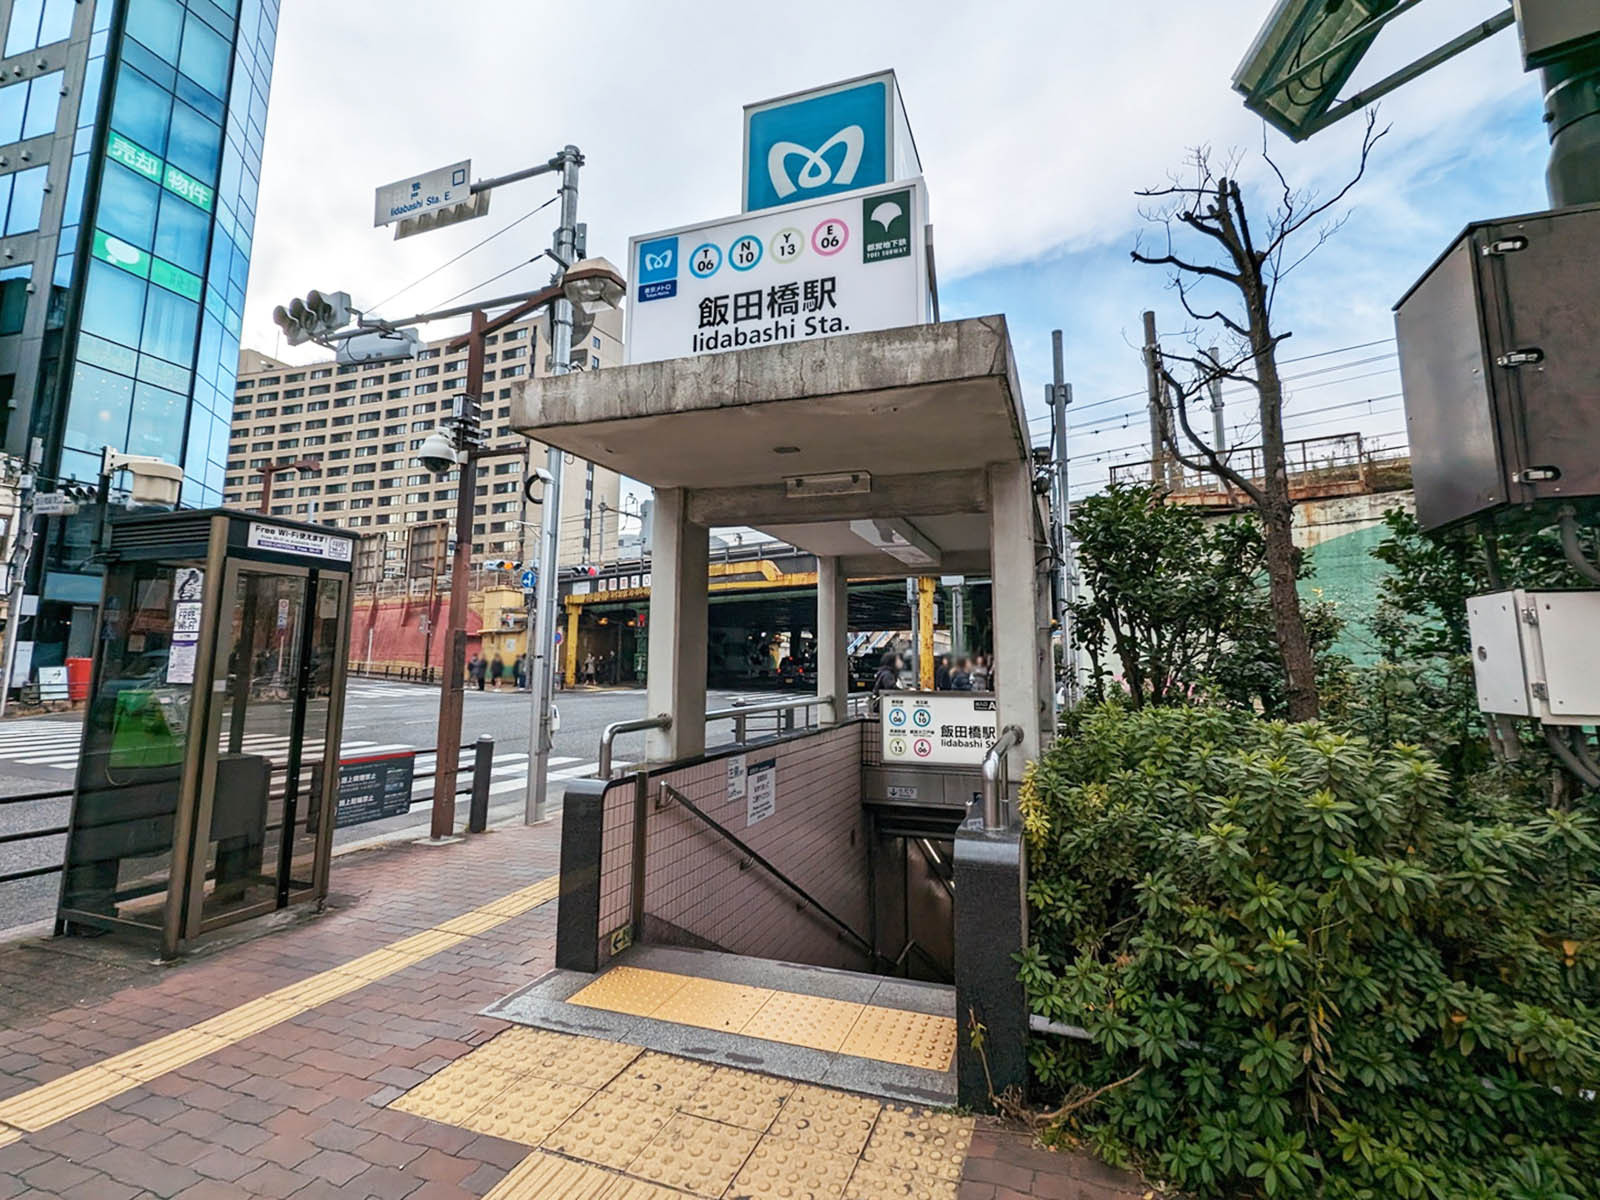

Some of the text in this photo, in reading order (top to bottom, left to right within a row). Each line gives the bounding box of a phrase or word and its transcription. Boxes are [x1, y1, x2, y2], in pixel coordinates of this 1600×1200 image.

[390, 200, 424, 216] Iidabashi
[827, 225, 834, 236] E
[784, 233, 791, 244] Y
[821, 236, 839, 248] 06
[741, 242, 751, 252] N
[780, 244, 796, 256] 13
[702, 249, 710, 258] T
[739, 252, 754, 264] 10
[698, 260, 714, 272] 06
[698, 277, 837, 329] 飯田橋駅
[692, 316, 850, 352] Iidabashi Sta.
[256, 525, 275, 535] Free
[940, 724, 996, 739] 飯田橋駅
[940, 739, 983, 748] Iidabashi
